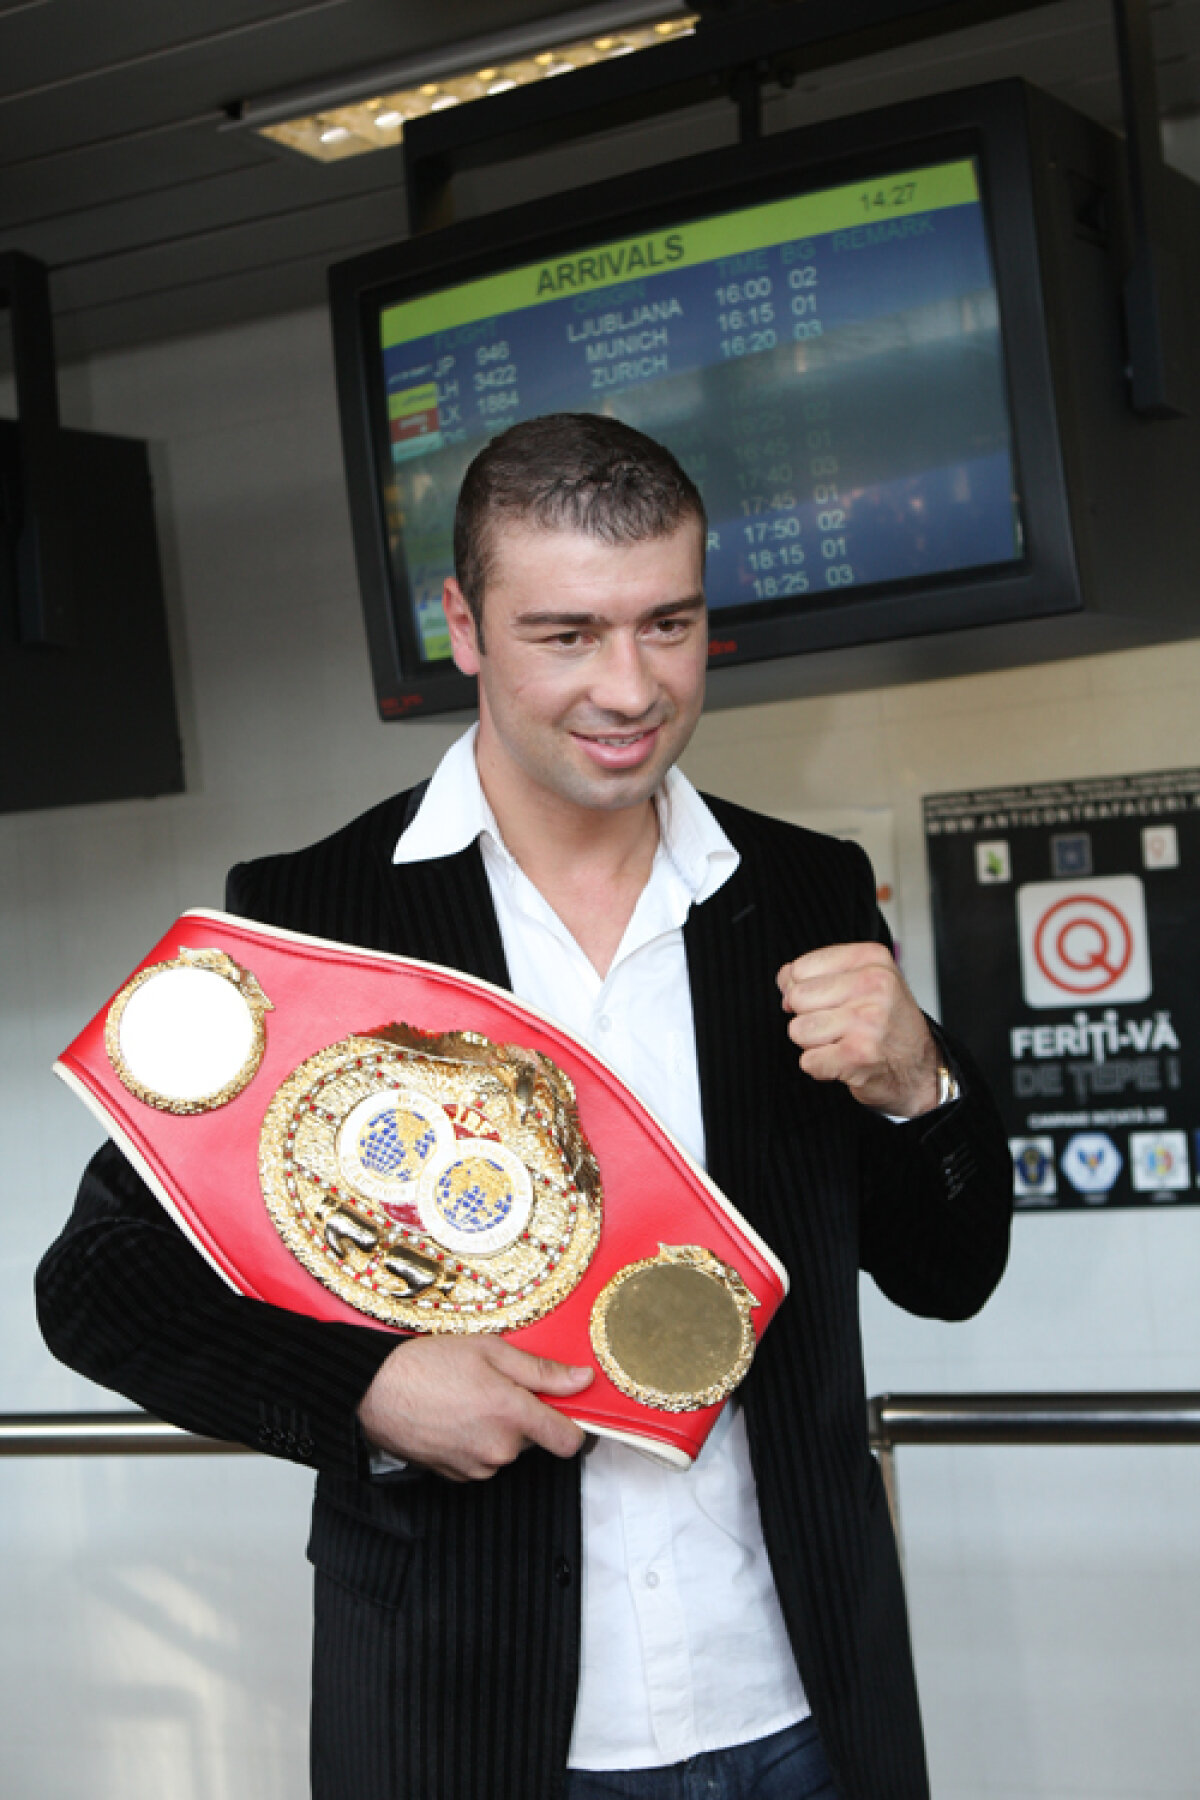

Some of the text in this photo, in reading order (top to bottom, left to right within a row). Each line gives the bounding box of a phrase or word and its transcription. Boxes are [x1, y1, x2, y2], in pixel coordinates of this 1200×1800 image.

[831, 215, 936, 254] REMARK
[537, 235, 685, 296] ARRIVALS
[566, 296, 685, 344] LJUBLJANA
[788, 265, 819, 290] 02
[436, 378, 461, 402] LH
[585, 325, 670, 364] MUNICH
[791, 293, 818, 317] 01
[590, 352, 670, 390] ZURICH
[793, 319, 824, 342] 03
[813, 484, 839, 505] 01
[743, 516, 802, 545] 17:50
[816, 507, 846, 532] 02
[748, 537, 847, 573] 18:15 01
[752, 563, 854, 600] 18:25 03
[1013, 1063, 1063, 1098] DE
